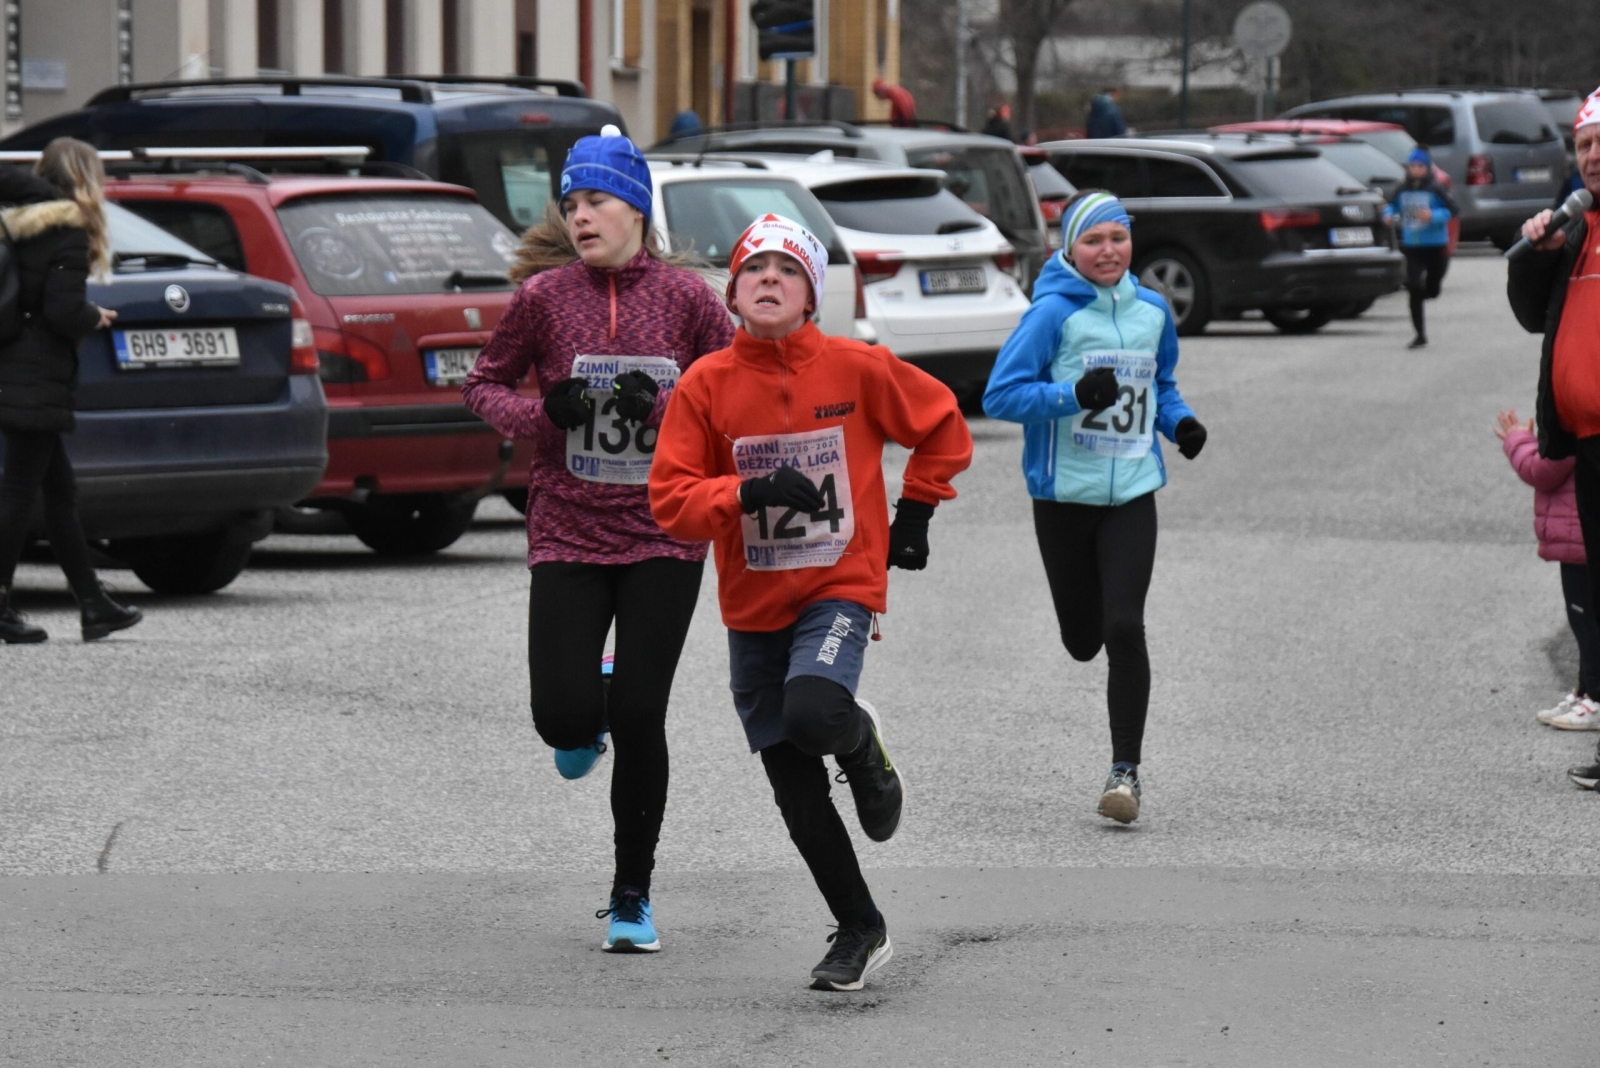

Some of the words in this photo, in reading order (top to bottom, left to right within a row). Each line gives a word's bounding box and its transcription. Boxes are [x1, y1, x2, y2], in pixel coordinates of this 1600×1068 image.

[130, 332, 168, 357] 6H9
[181, 331, 229, 356] 3691
[439, 351, 469, 375] 3H4
[577, 360, 619, 375] ZIMNÍ
[1086, 354, 1119, 366] ZIMNÍ
[624, 368, 678, 376] 20-2021
[1135, 369, 1152, 379] LIGA
[585, 377, 616, 389] ĚŽEC
[736, 440, 779, 457] ZIMNÍ
[737, 454, 802, 470] BĚŽECKÁ
[807, 450, 840, 467] LIGA
[757, 473, 845, 540] 124
[816, 634, 842, 665] NAGEUR
